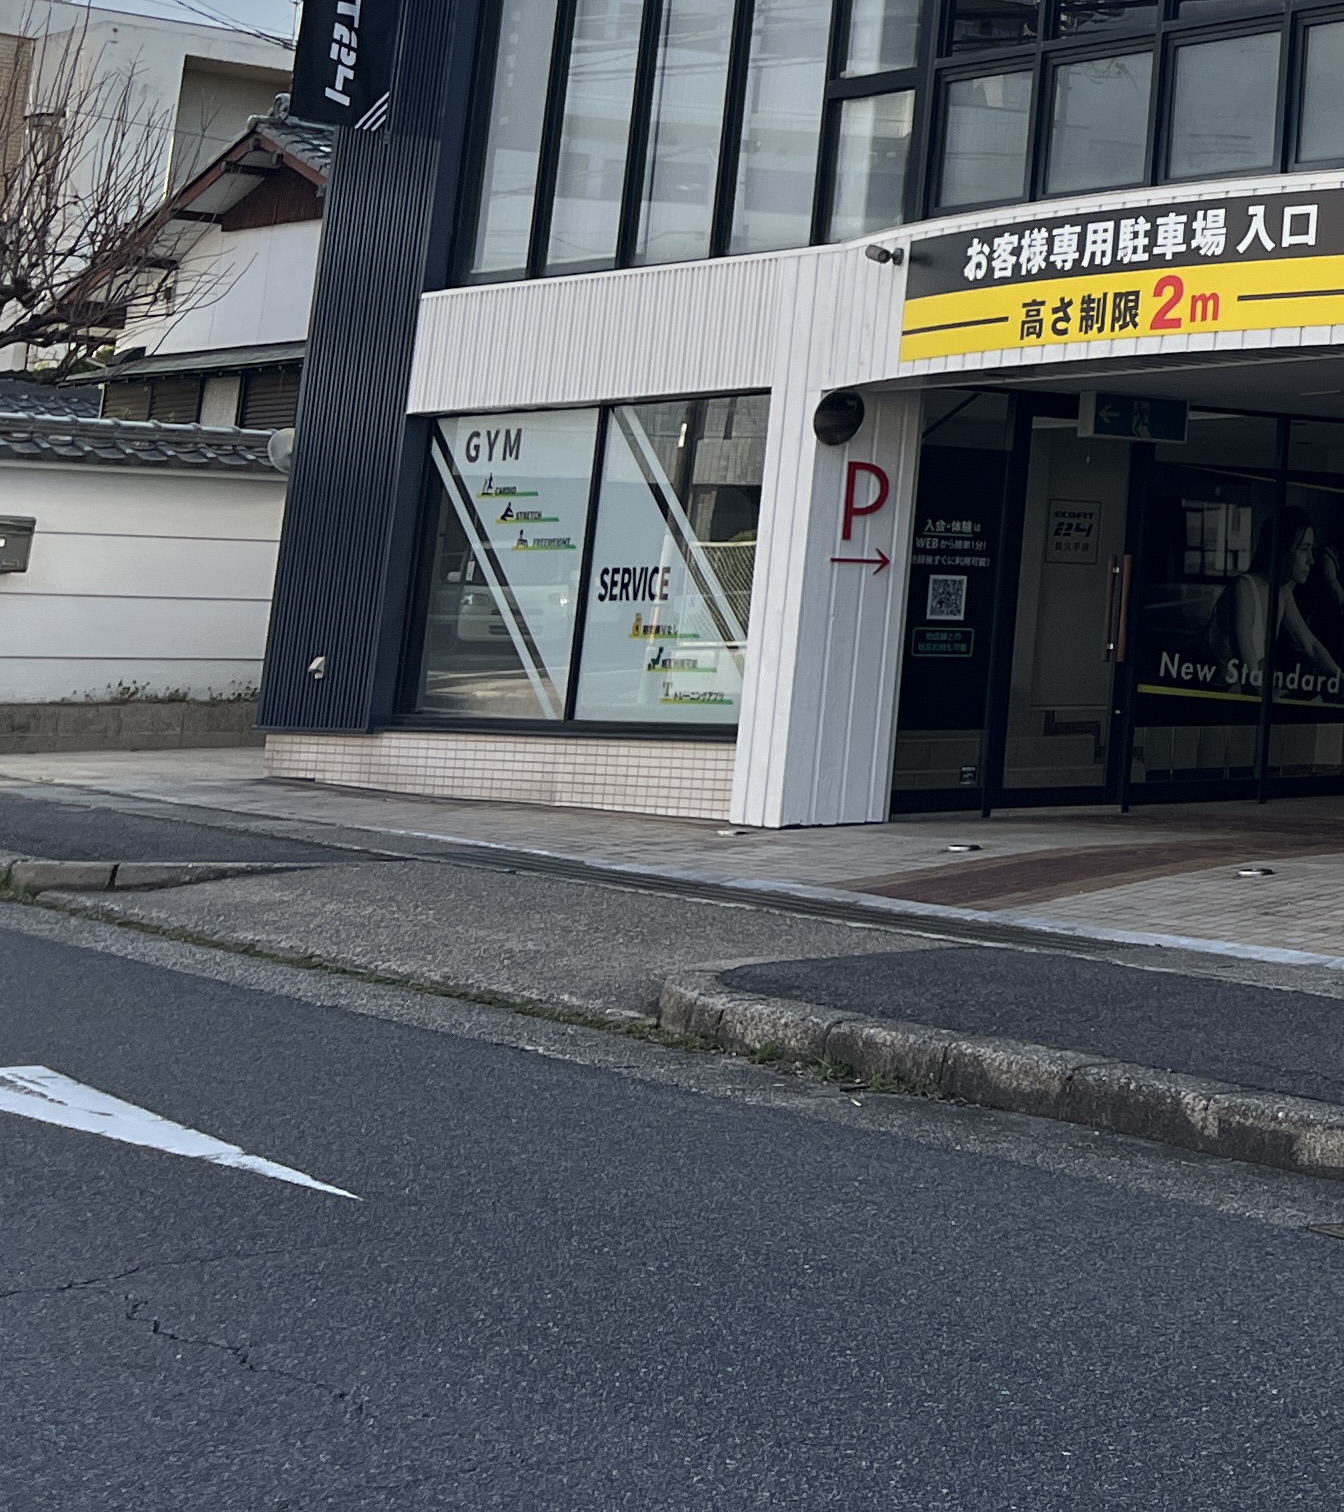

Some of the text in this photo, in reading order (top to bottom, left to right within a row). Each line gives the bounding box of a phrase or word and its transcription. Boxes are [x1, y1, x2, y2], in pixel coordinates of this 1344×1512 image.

[963, 209, 1228, 281] お客様専用駐車場
[465, 428, 523, 462] GYM
[841, 461, 890, 541] P
[598, 566, 671, 602] SERVICE
[1158, 651, 1216, 682] New
[1226, 658, 1342, 695] Standard
